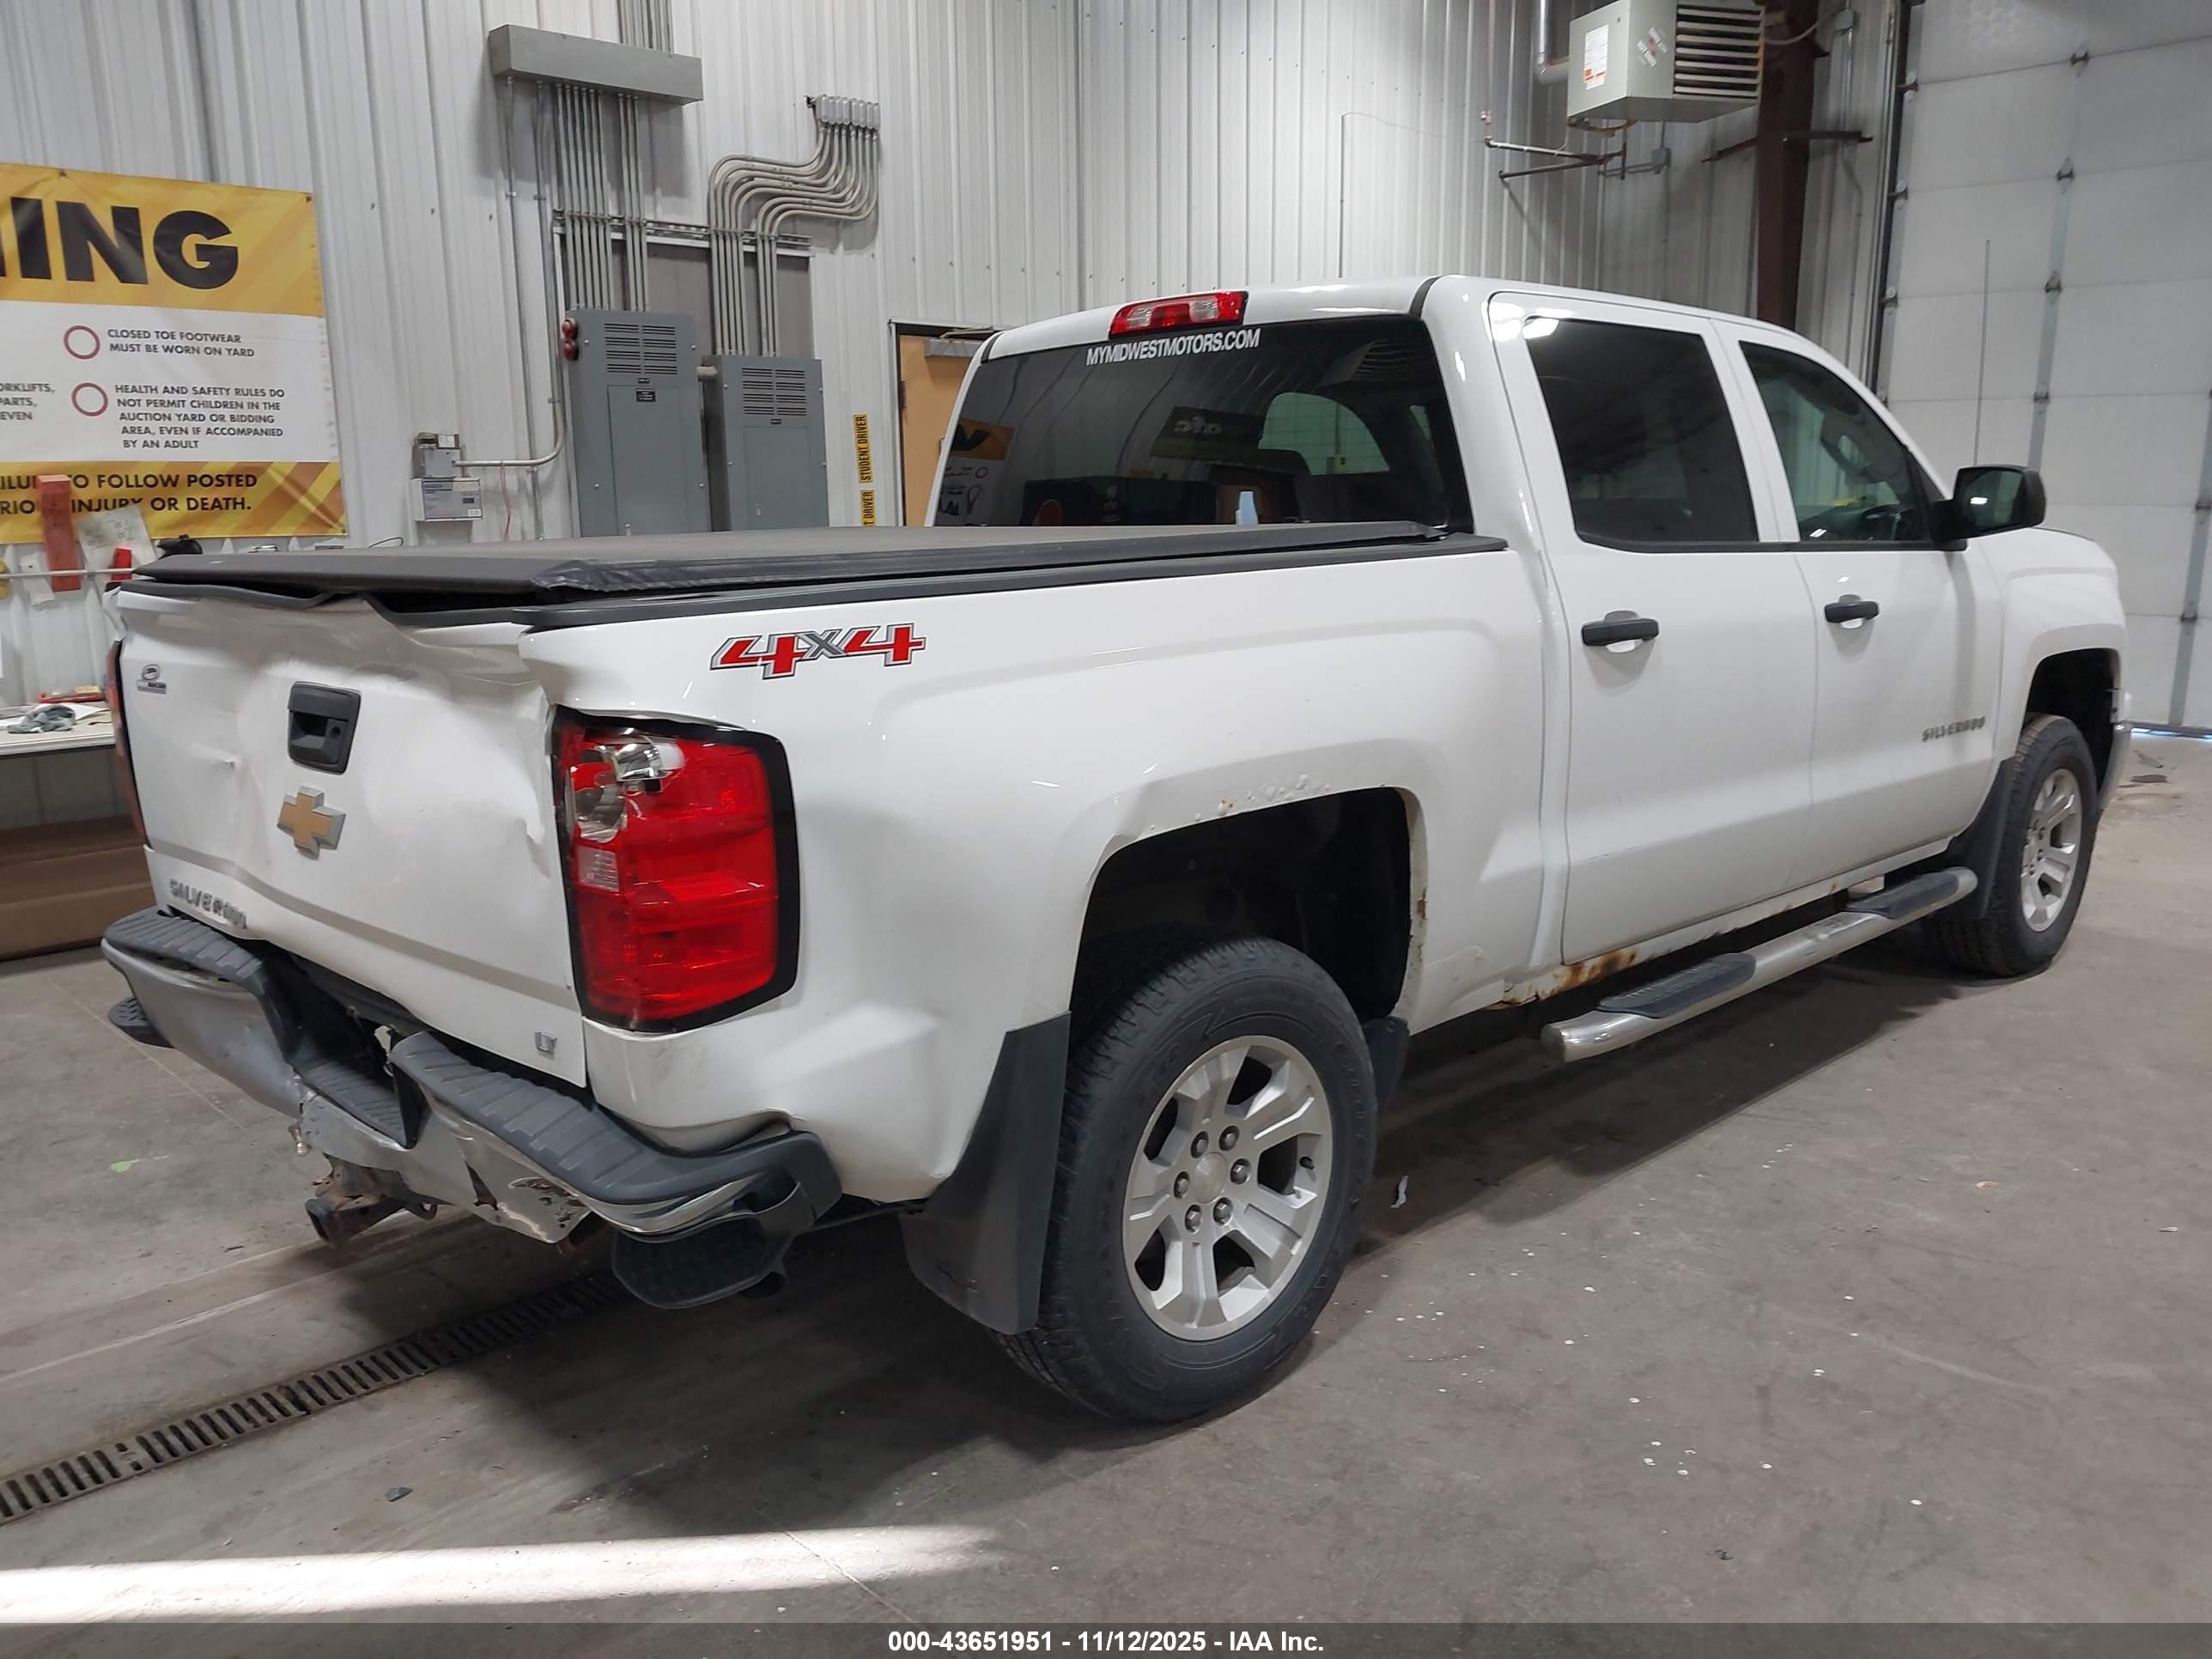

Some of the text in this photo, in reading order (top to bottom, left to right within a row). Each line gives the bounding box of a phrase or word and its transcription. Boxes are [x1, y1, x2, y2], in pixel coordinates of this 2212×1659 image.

[0, 196, 239, 290] ING
[107, 329, 241, 343] CLOSED TOE FOOTWEAR
[109, 343, 254, 357] MUST BE WORN ON YARD
[1085, 327, 1261, 367] MYMIDWESTMOTORS.COM
[115, 384, 285, 398] HEALTH AND SAFETY RULES DO
[117, 398, 281, 410] NOT PERMIT CHILDREN IN THE
[0, 411, 33, 421] EVEN
[119, 412, 275, 423] AUCTION YARD OR BIDDING
[121, 426, 283, 437] AREA, EVEN IF ACCOMPANIED
[123, 440, 199, 449] BY AN ADULT
[856, 415, 872, 481] STUDENT DRIVER
[0, 473, 257, 489] ILU O FOLLOW POSTED
[0, 500, 40, 515] RIO
[150, 497, 179, 512] OR
[187, 496, 252, 511] DEATH.
